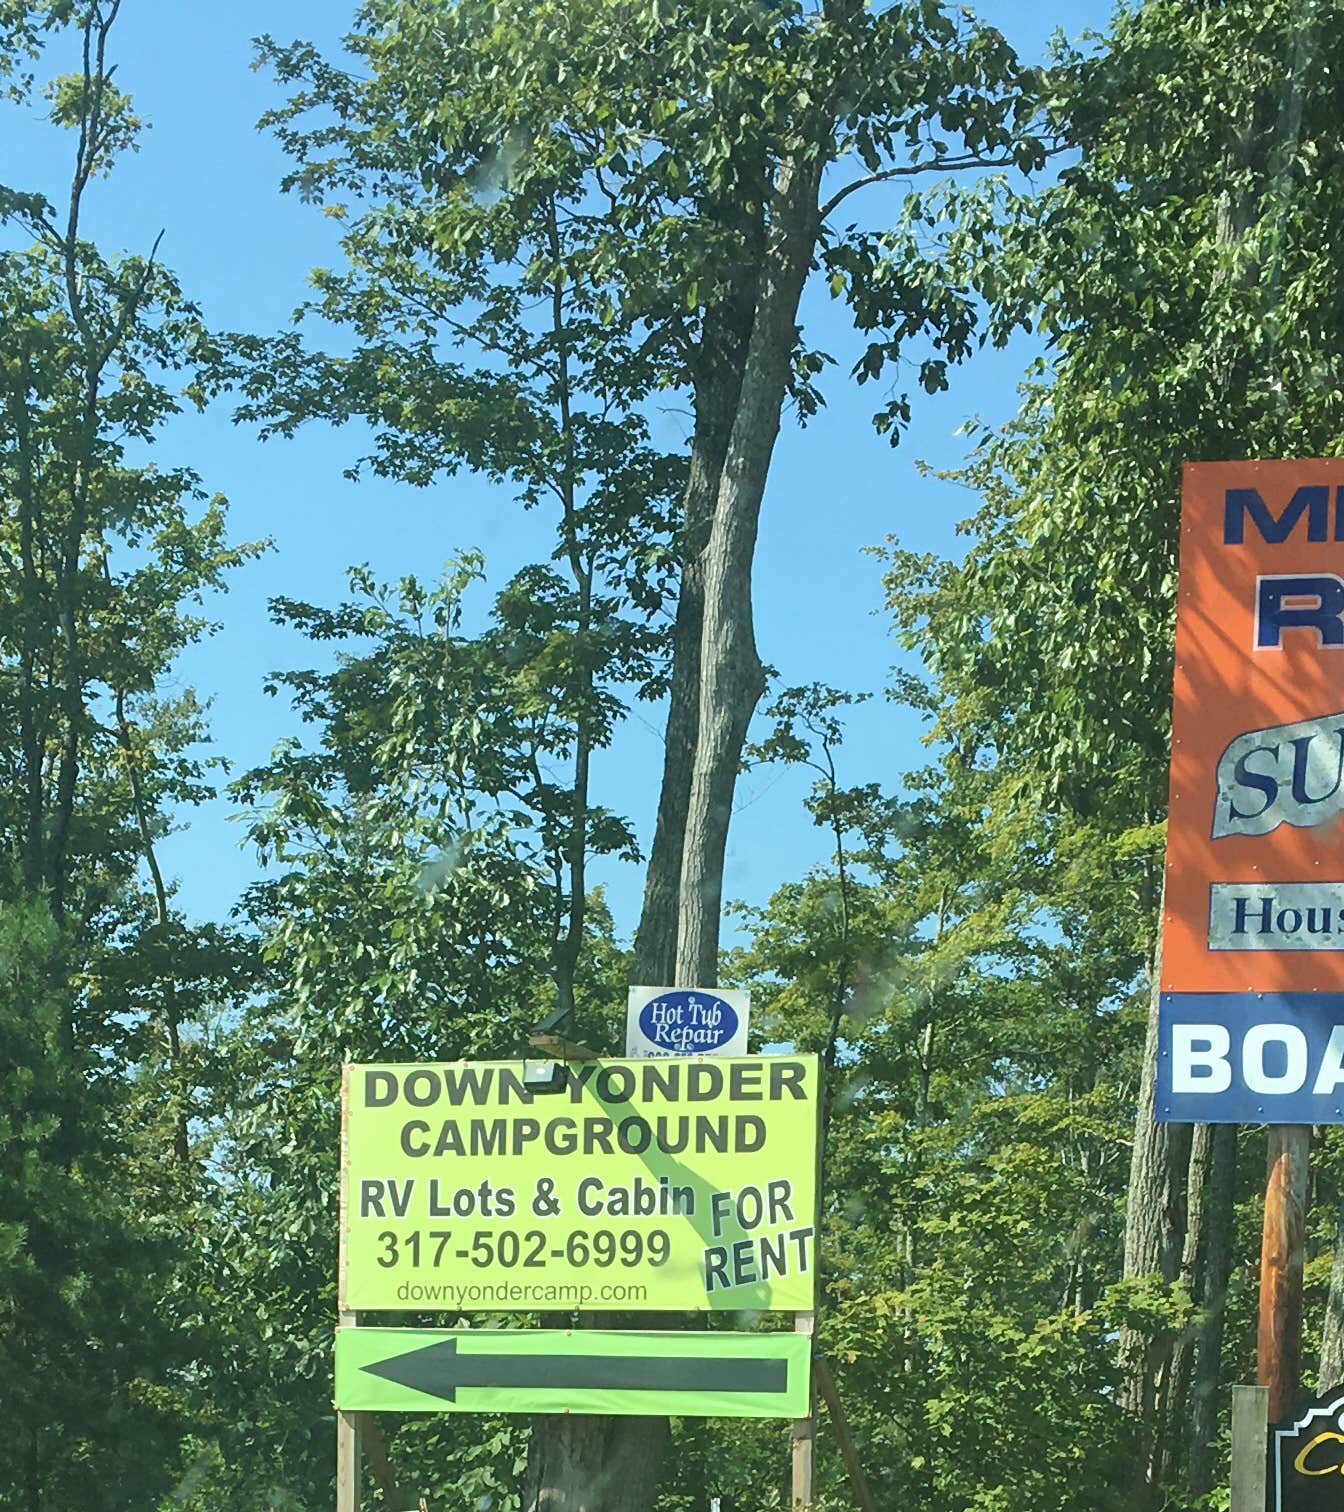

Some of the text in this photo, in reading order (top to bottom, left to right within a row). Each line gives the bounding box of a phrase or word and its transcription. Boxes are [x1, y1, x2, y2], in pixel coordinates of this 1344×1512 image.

[650, 1000, 722, 1028] Hot Tub
[655, 1024, 724, 1051] Repair
[566, 1062, 808, 1104] YONDER
[400, 1115, 767, 1158] CAMPGROUND
[360, 1176, 695, 1217] RV Lots & Cabin
[711, 1179, 795, 1236] FOR
[377, 1230, 672, 1269] 317-502-6999
[704, 1227, 815, 1293] RENT
[397, 1281, 647, 1304] downyondercamp.com
